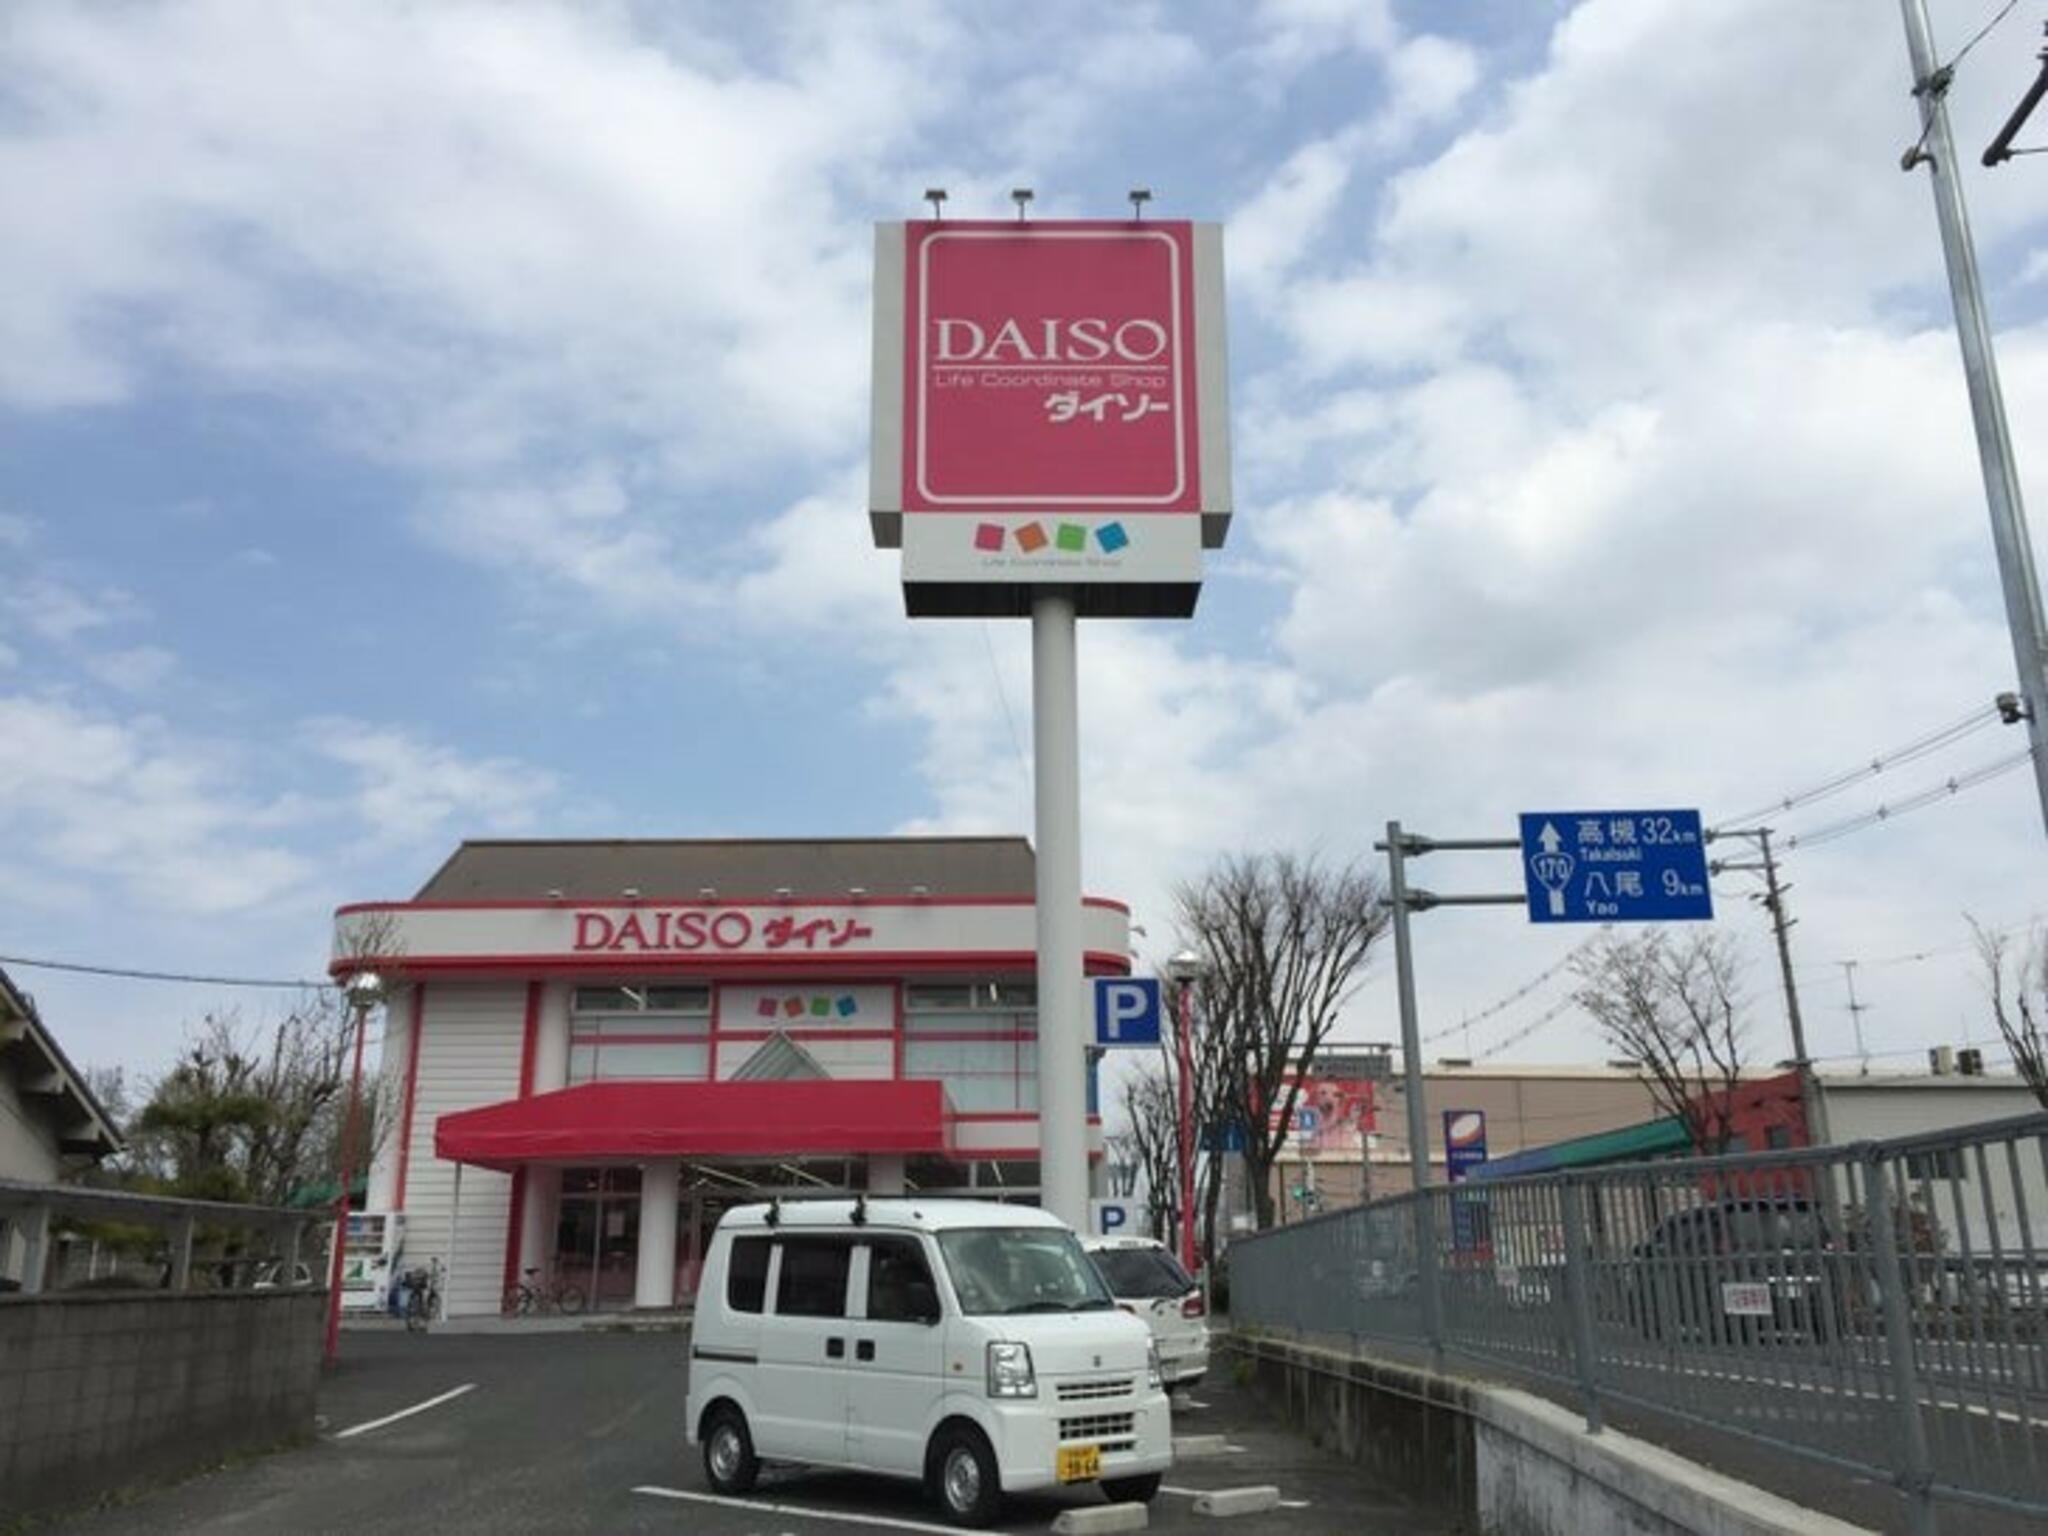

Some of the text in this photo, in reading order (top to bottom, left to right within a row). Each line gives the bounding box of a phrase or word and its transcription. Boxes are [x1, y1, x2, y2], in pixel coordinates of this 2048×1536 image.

[932, 317, 1168, 362] DAISO
[935, 373, 1167, 389] Life Coordinate Shop
[1044, 390, 1169, 423] ダイソー
[1538, 857, 1569, 881] 170
[1583, 871, 1644, 897] 八尾
[1586, 902, 1619, 915] Yao
[573, 912, 752, 950] DAISO
[762, 916, 872, 948] ダイソー
[1106, 984, 1149, 1039] P
[1101, 1206, 1126, 1235] P
